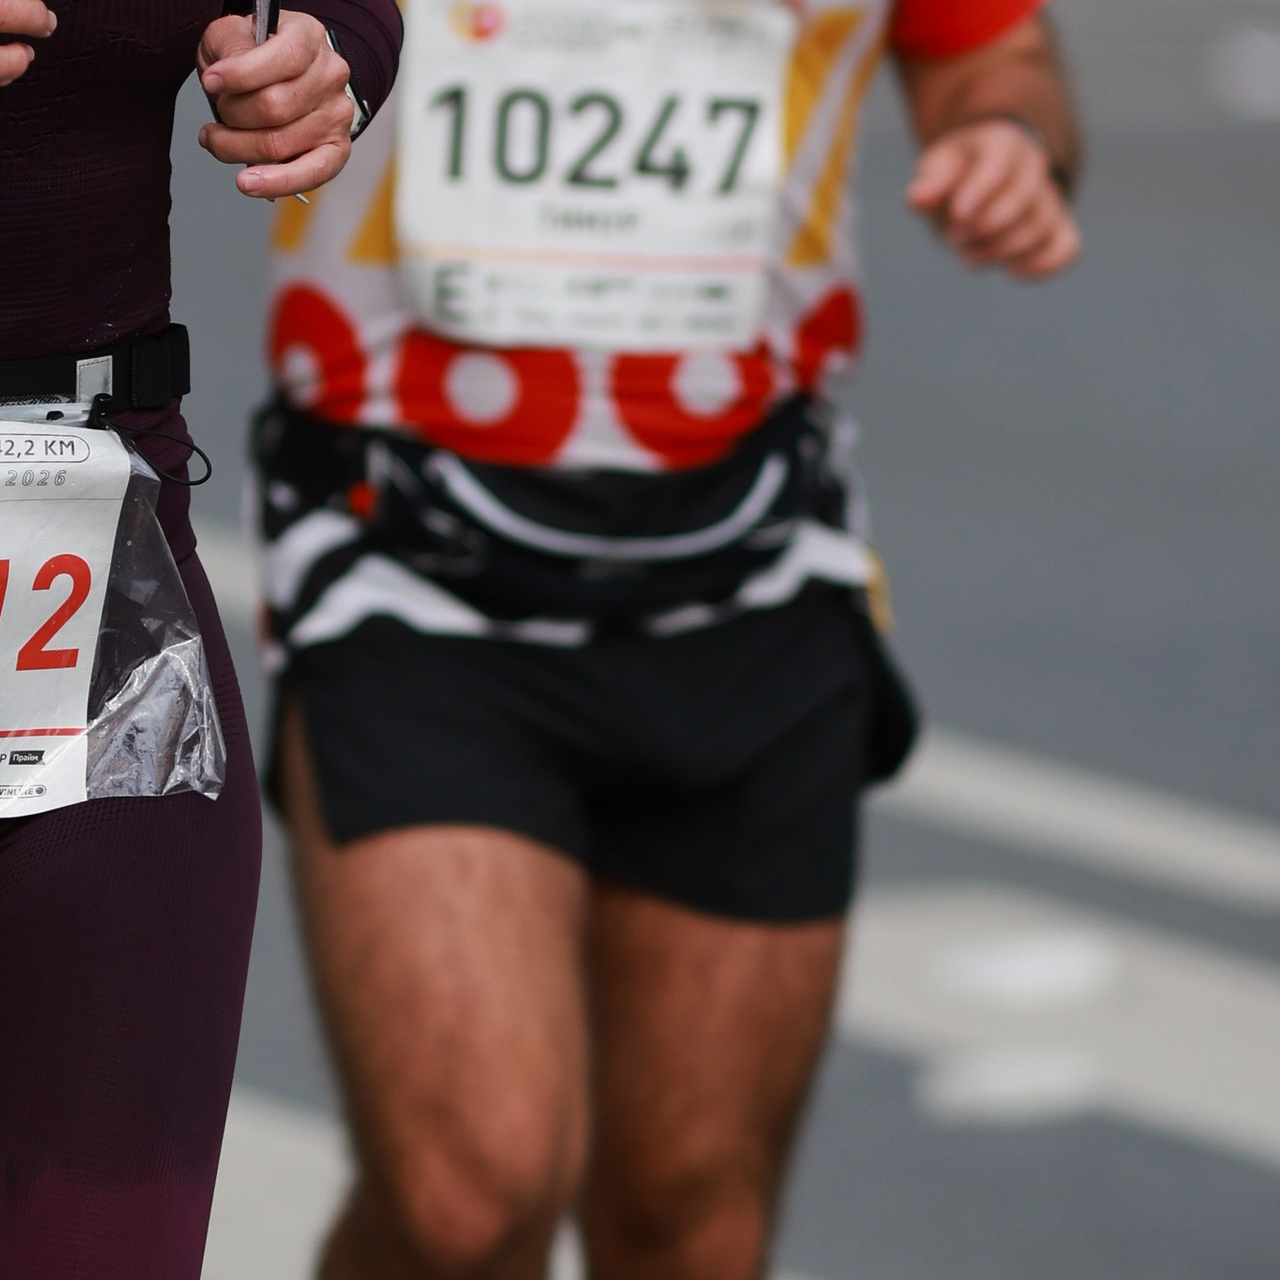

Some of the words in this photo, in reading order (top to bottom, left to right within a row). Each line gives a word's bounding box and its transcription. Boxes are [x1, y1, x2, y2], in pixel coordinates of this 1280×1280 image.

[430, 83, 762, 196] 10247
[434, 261, 470, 323] E
[44, 440, 76, 456] КМ
[5, 470, 67, 486] 2026
[12, 753, 38, 762] Прайм
